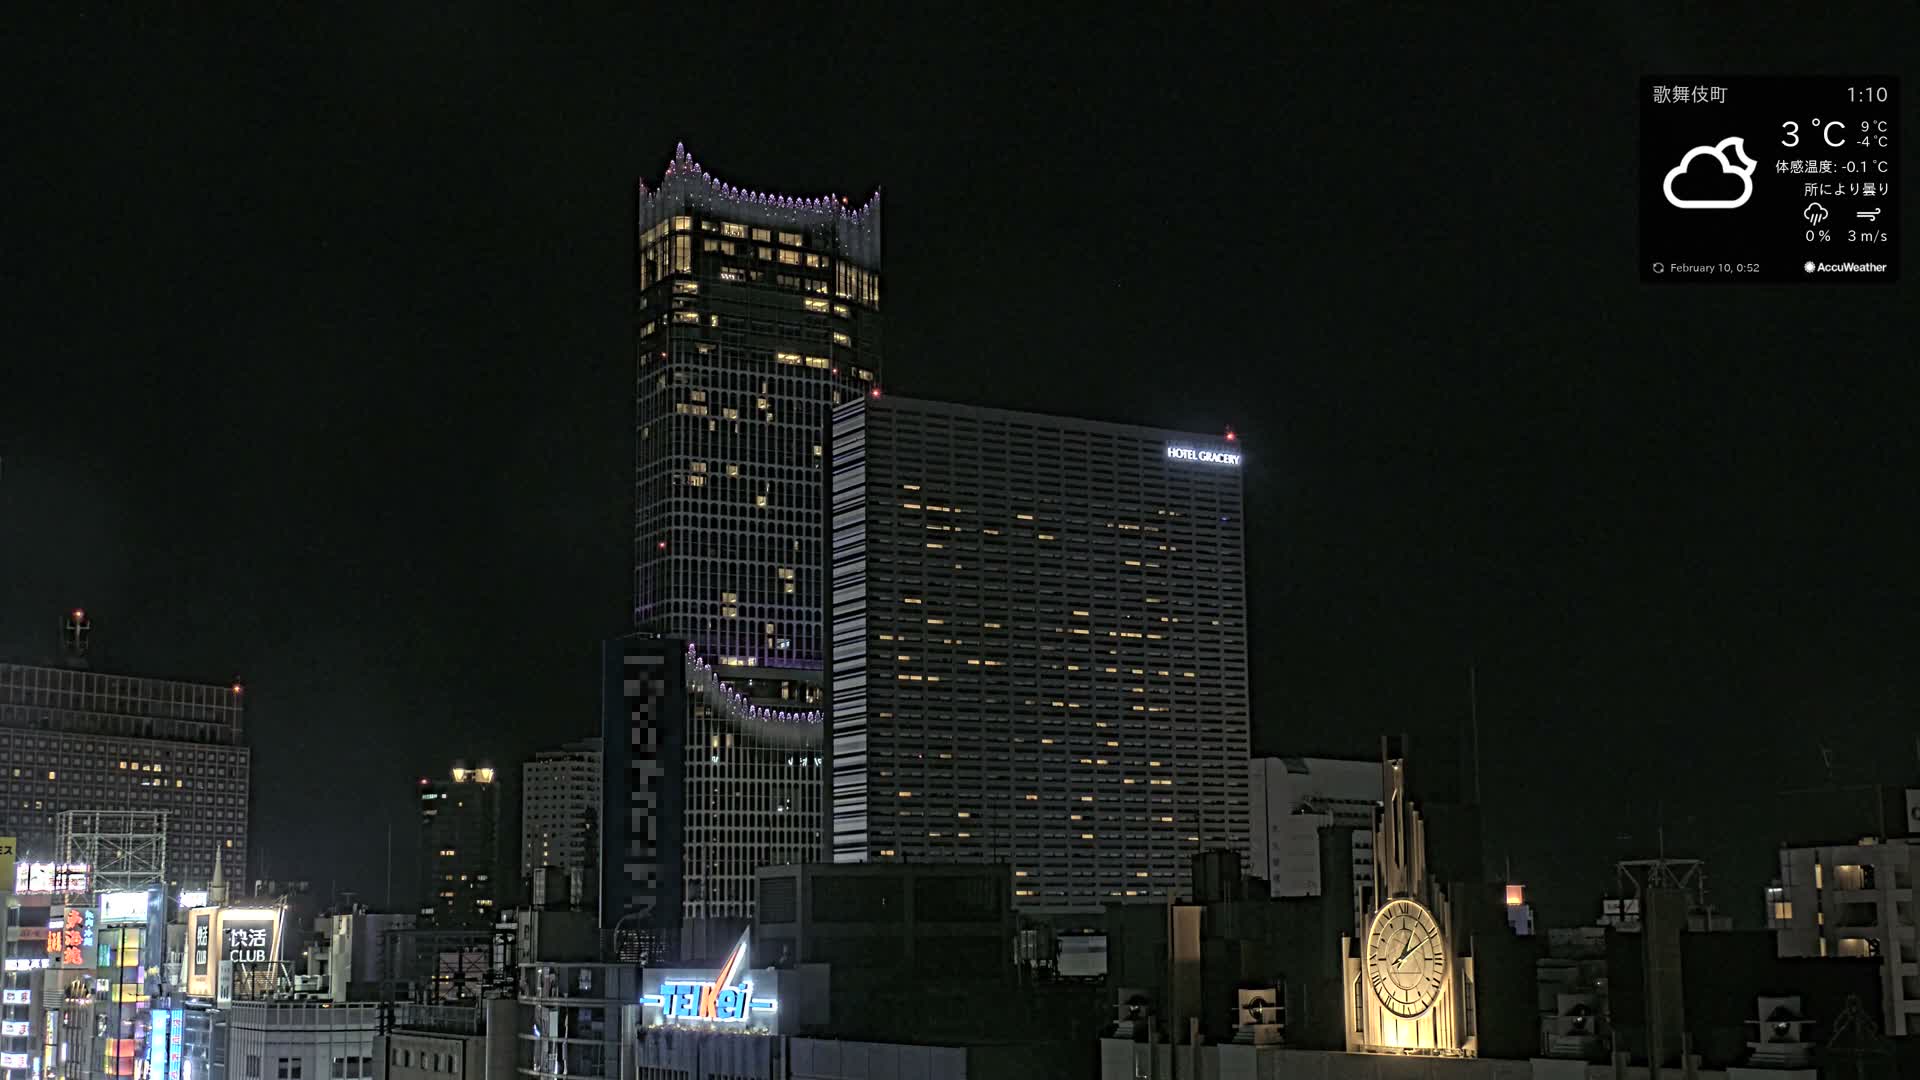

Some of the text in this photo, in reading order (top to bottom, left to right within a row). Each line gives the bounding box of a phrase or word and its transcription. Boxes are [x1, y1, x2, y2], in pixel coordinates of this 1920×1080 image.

[1167, 447, 1240, 465] HOTEL GRACERY
[229, 928, 267, 948] 快活
[230, 949, 266, 963] CLUB
